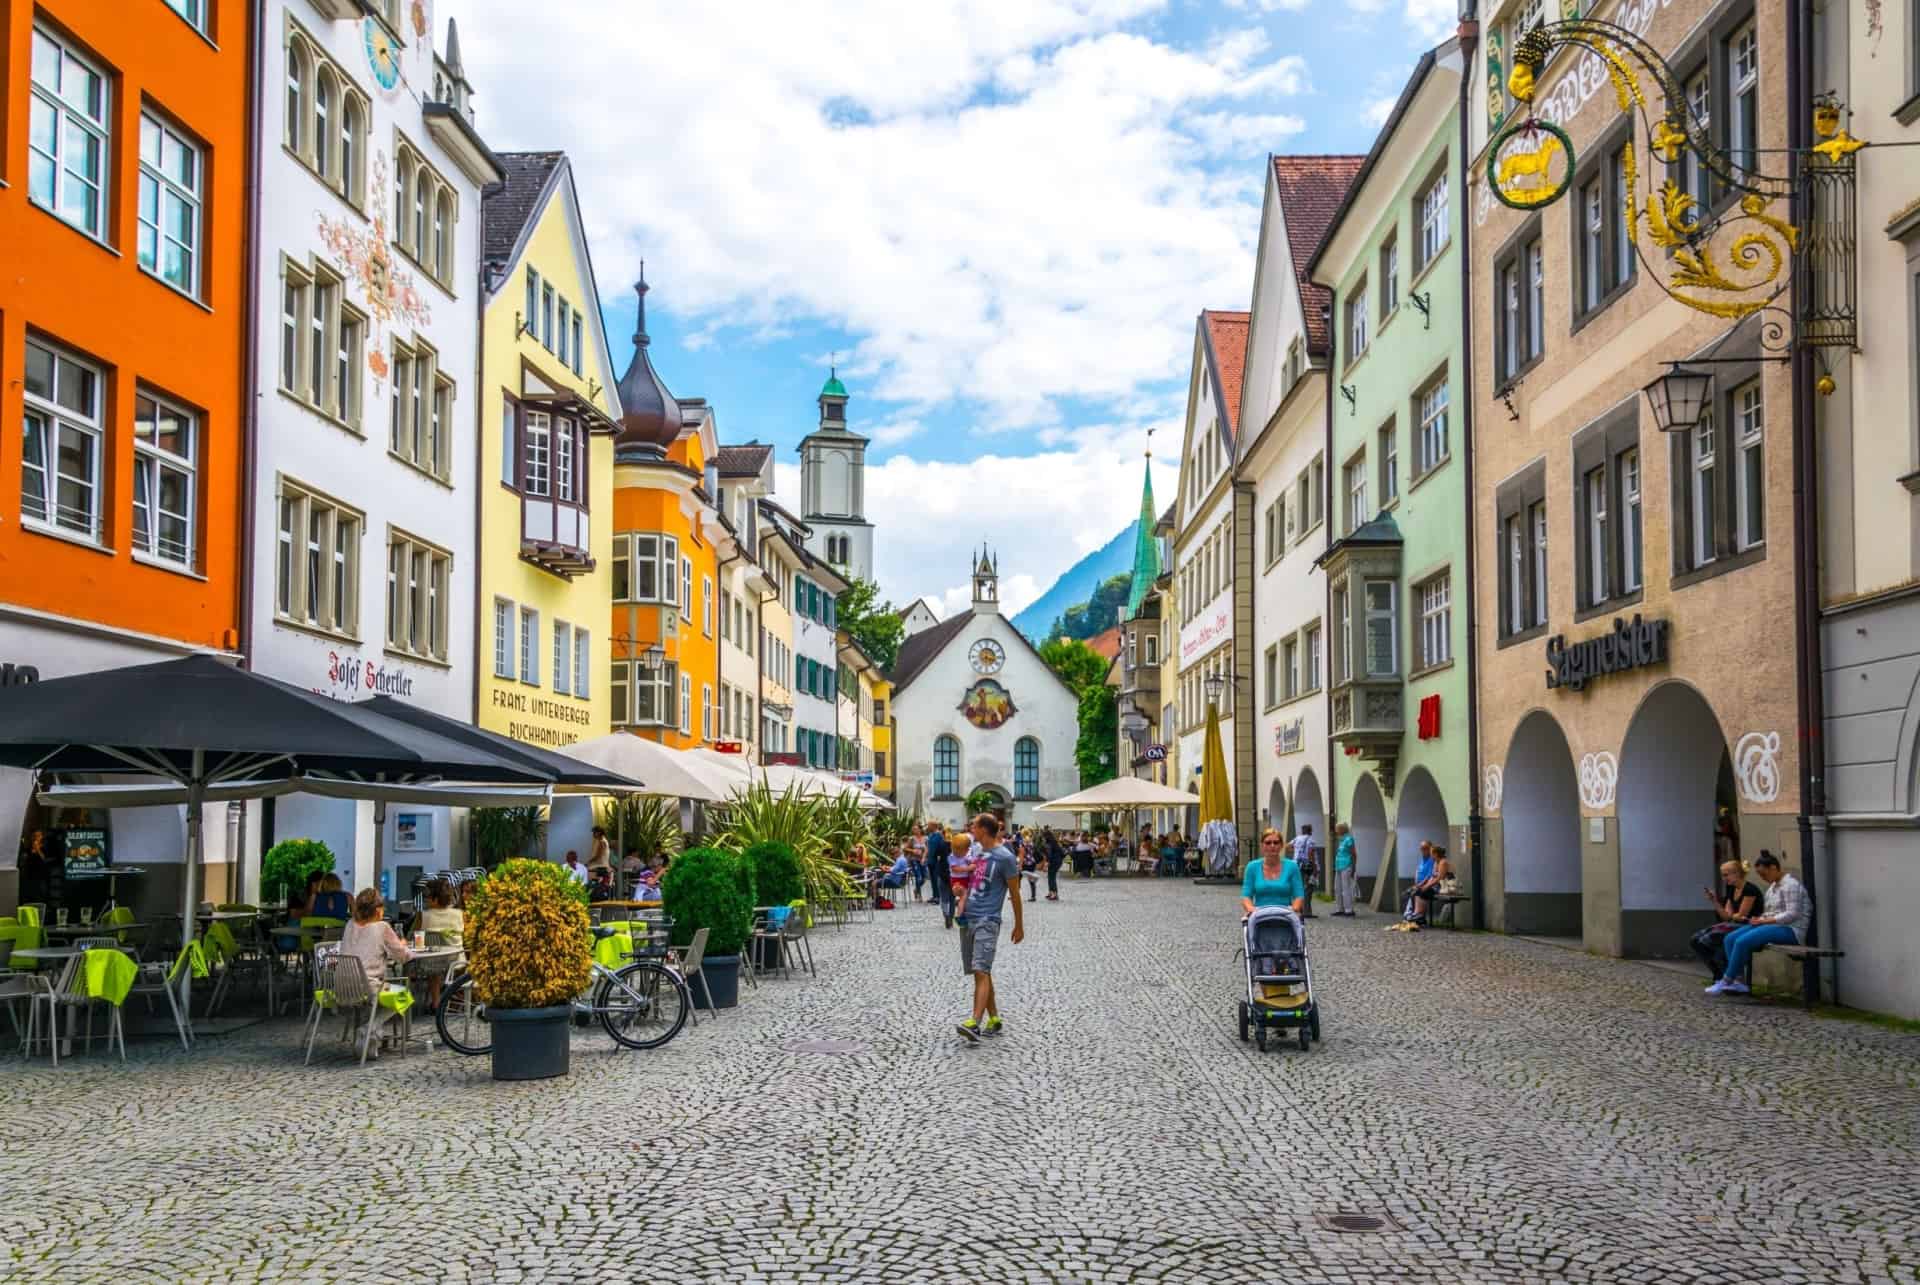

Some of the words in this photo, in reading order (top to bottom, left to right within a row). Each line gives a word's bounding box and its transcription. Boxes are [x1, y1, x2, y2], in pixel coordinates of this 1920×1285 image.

[328, 651, 361, 691] Josef
[365, 661, 413, 697] Schertler
[1546, 614, 1668, 691] Sagmeister
[493, 689, 527, 712] FRANZ
[532, 698, 590, 725] UNTERBERGER
